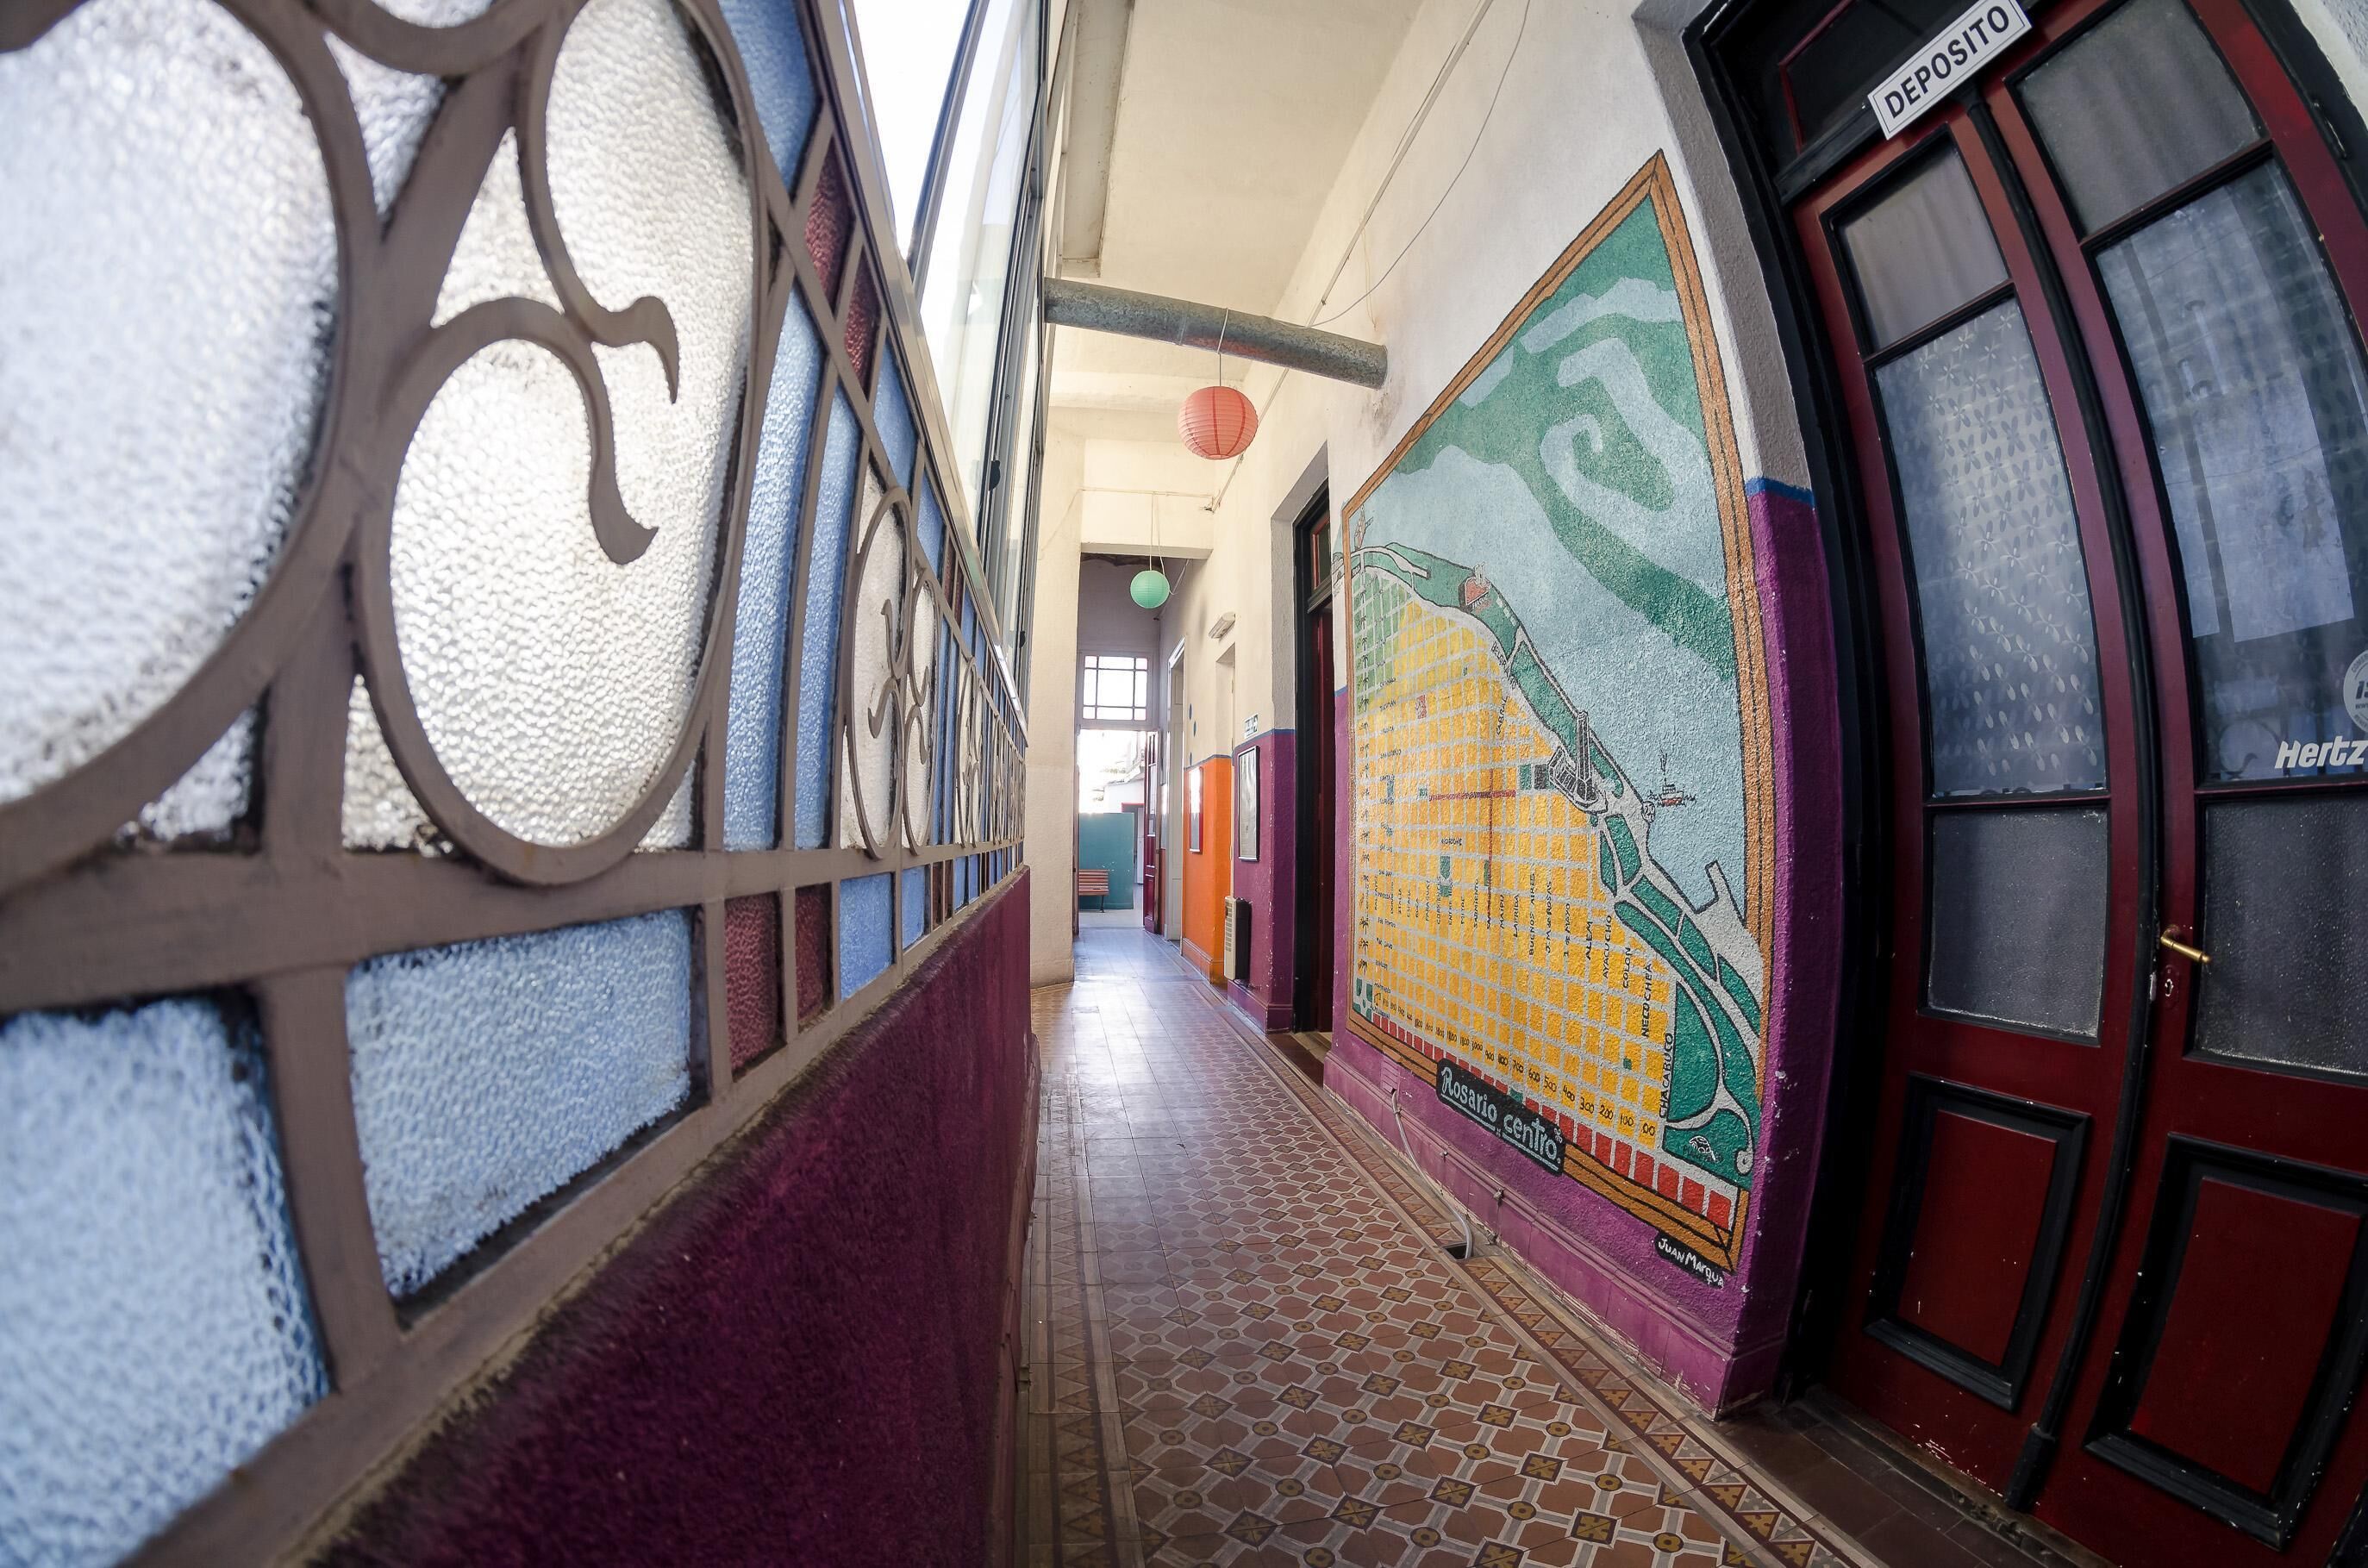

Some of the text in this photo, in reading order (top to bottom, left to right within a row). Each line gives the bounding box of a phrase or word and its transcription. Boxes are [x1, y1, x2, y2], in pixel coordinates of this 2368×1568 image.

[1884, 6, 2009, 119] DEPOSITO
[2274, 735, 2368, 769] Hertz
[1603, 915, 1612, 979] AYACUCHO
[1623, 946, 1632, 989] COLON
[1641, 963, 1653, 1038] NECOCHEA
[1440, 1066, 1498, 1123] Rosario
[1484, 1050, 1494, 1061] 900
[1512, 1059, 1524, 1073] 700
[1528, 1068, 1540, 1083] 600
[1544, 1075, 1557, 1092] 500
[1563, 1084, 1575, 1103] 400
[1579, 1096, 1595, 1114] 300
[1599, 1104, 1614, 1121] 200
[1620, 1114, 1634, 1127] 100
[1659, 1033, 1674, 1119] CHACABUCO
